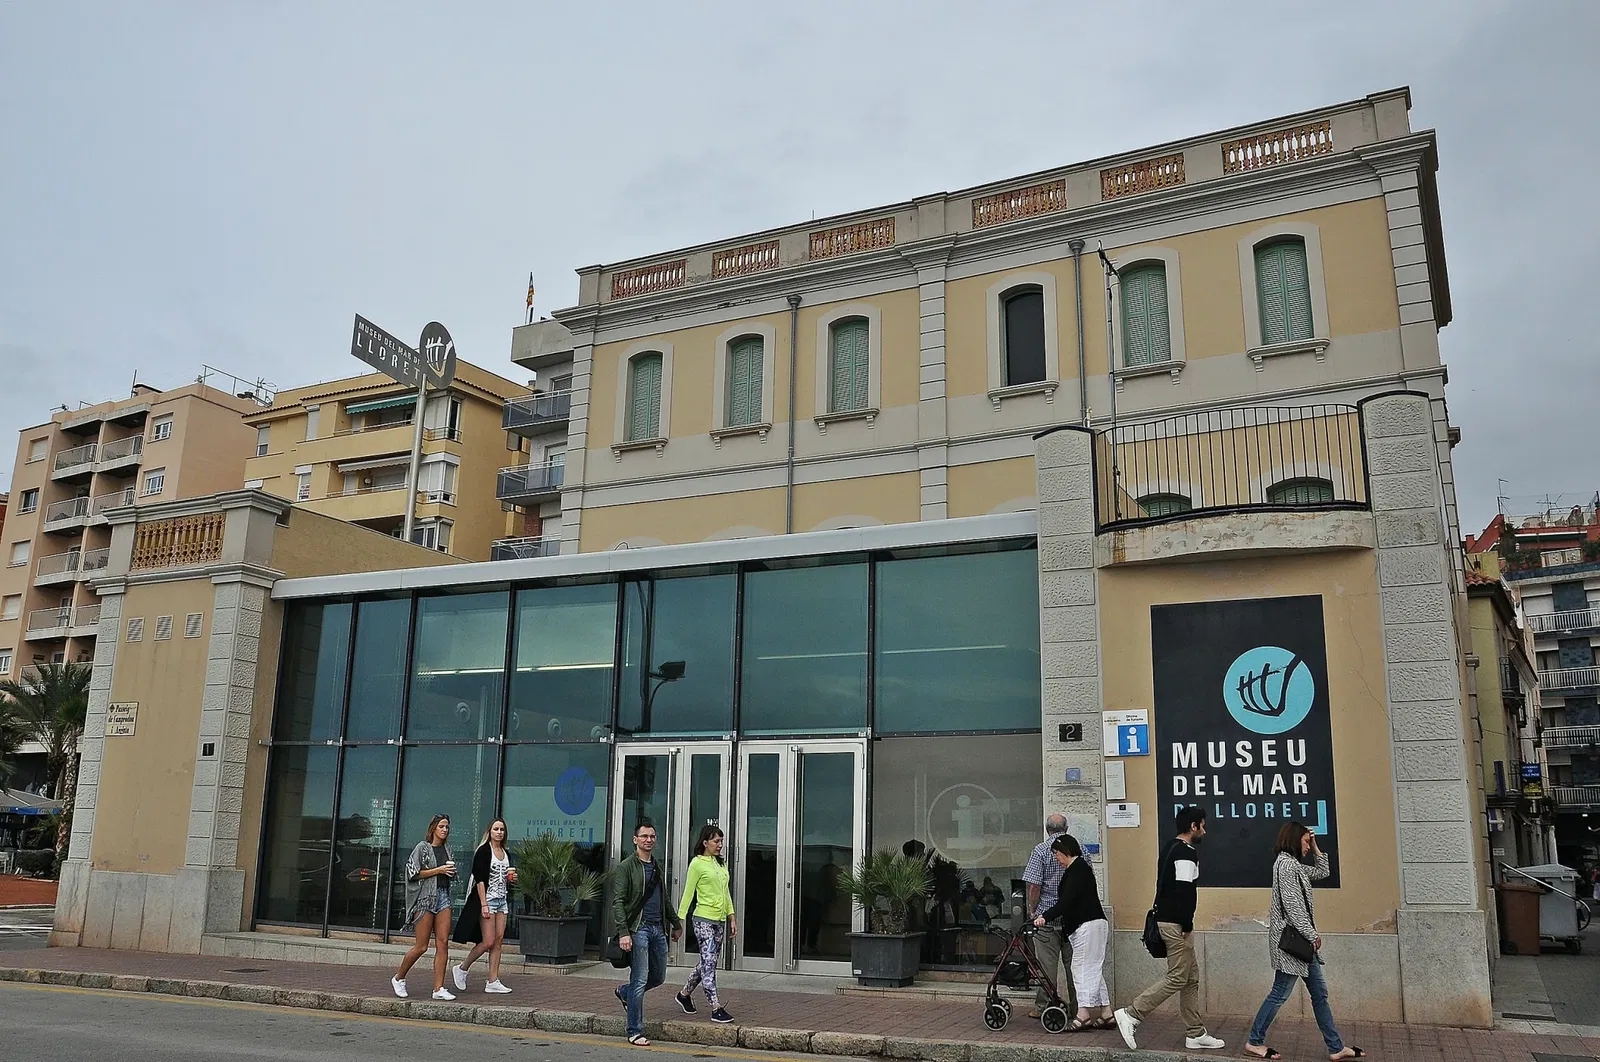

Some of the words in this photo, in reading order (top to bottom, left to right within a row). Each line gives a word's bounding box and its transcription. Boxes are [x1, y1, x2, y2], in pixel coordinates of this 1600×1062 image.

[358, 321, 382, 341] MUSEU
[384, 338, 396, 351] DEL
[398, 346, 411, 360] MAR
[356, 332, 420, 381] LLORET
[1065, 724, 1076, 740] 2
[1172, 739, 1307, 769] MUSEU
[1173, 775, 1225, 796] DEL
[1242, 773, 1309, 796] MAR
[1215, 802, 1309, 818] LLORET
[526, 827, 586, 838] LLORET
